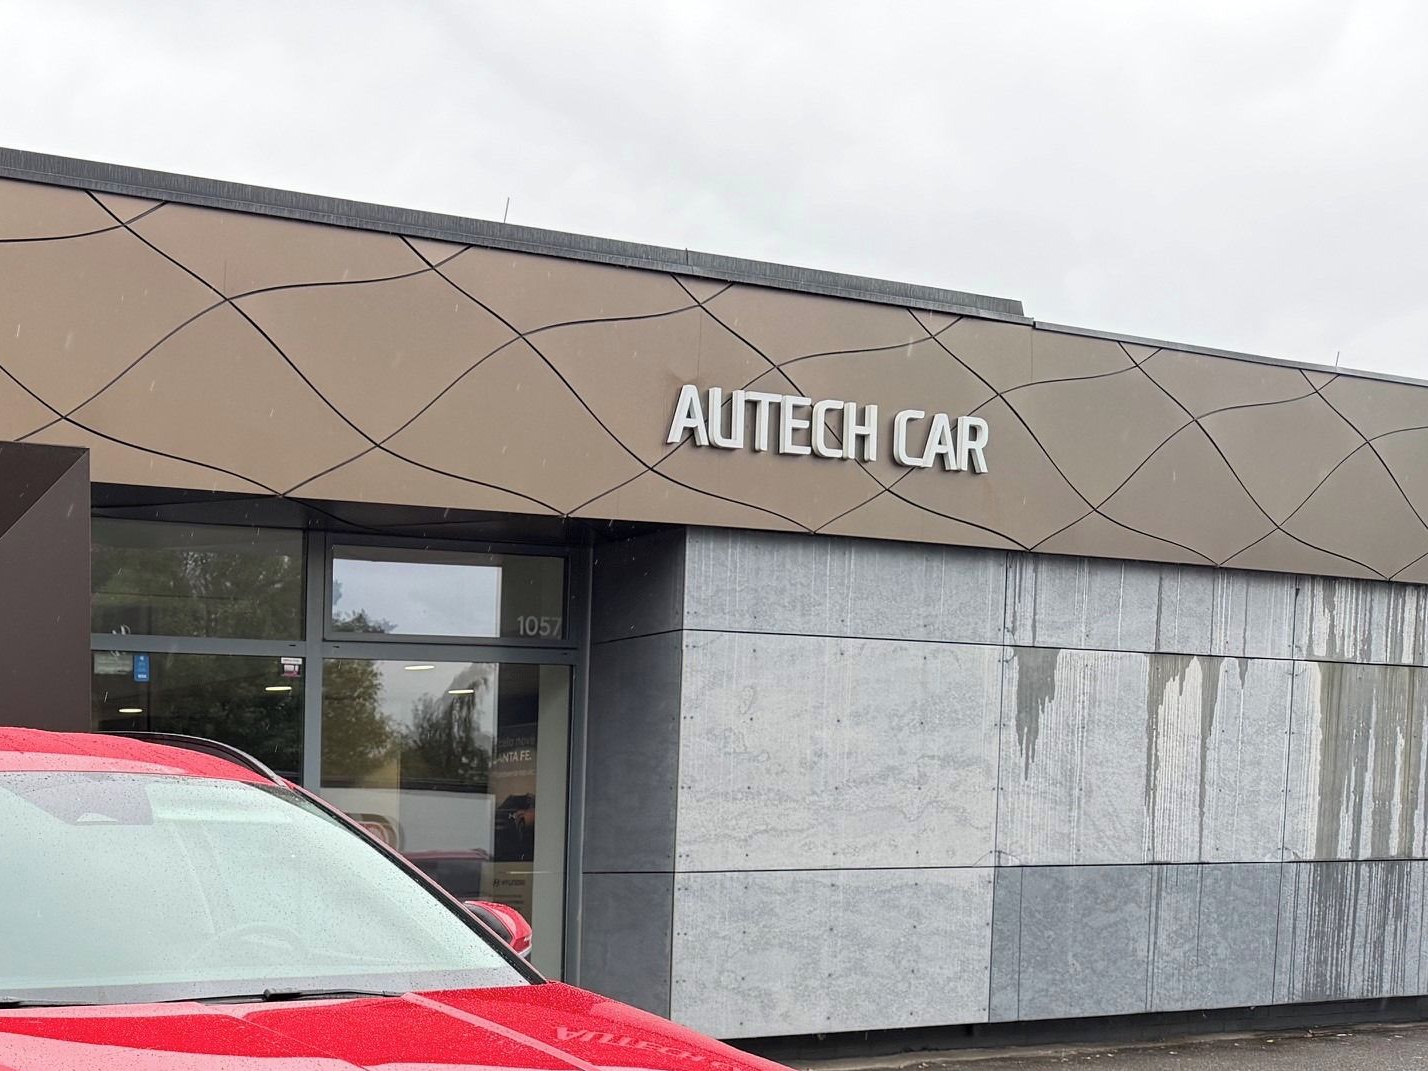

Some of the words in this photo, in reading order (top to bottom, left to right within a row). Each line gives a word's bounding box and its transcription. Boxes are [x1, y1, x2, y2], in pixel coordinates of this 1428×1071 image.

[667, 384, 878, 462] AUTECH
[893, 409, 989, 473] CAR
[517, 615, 562, 636] 1057
[493, 751, 518, 763] ANTA
